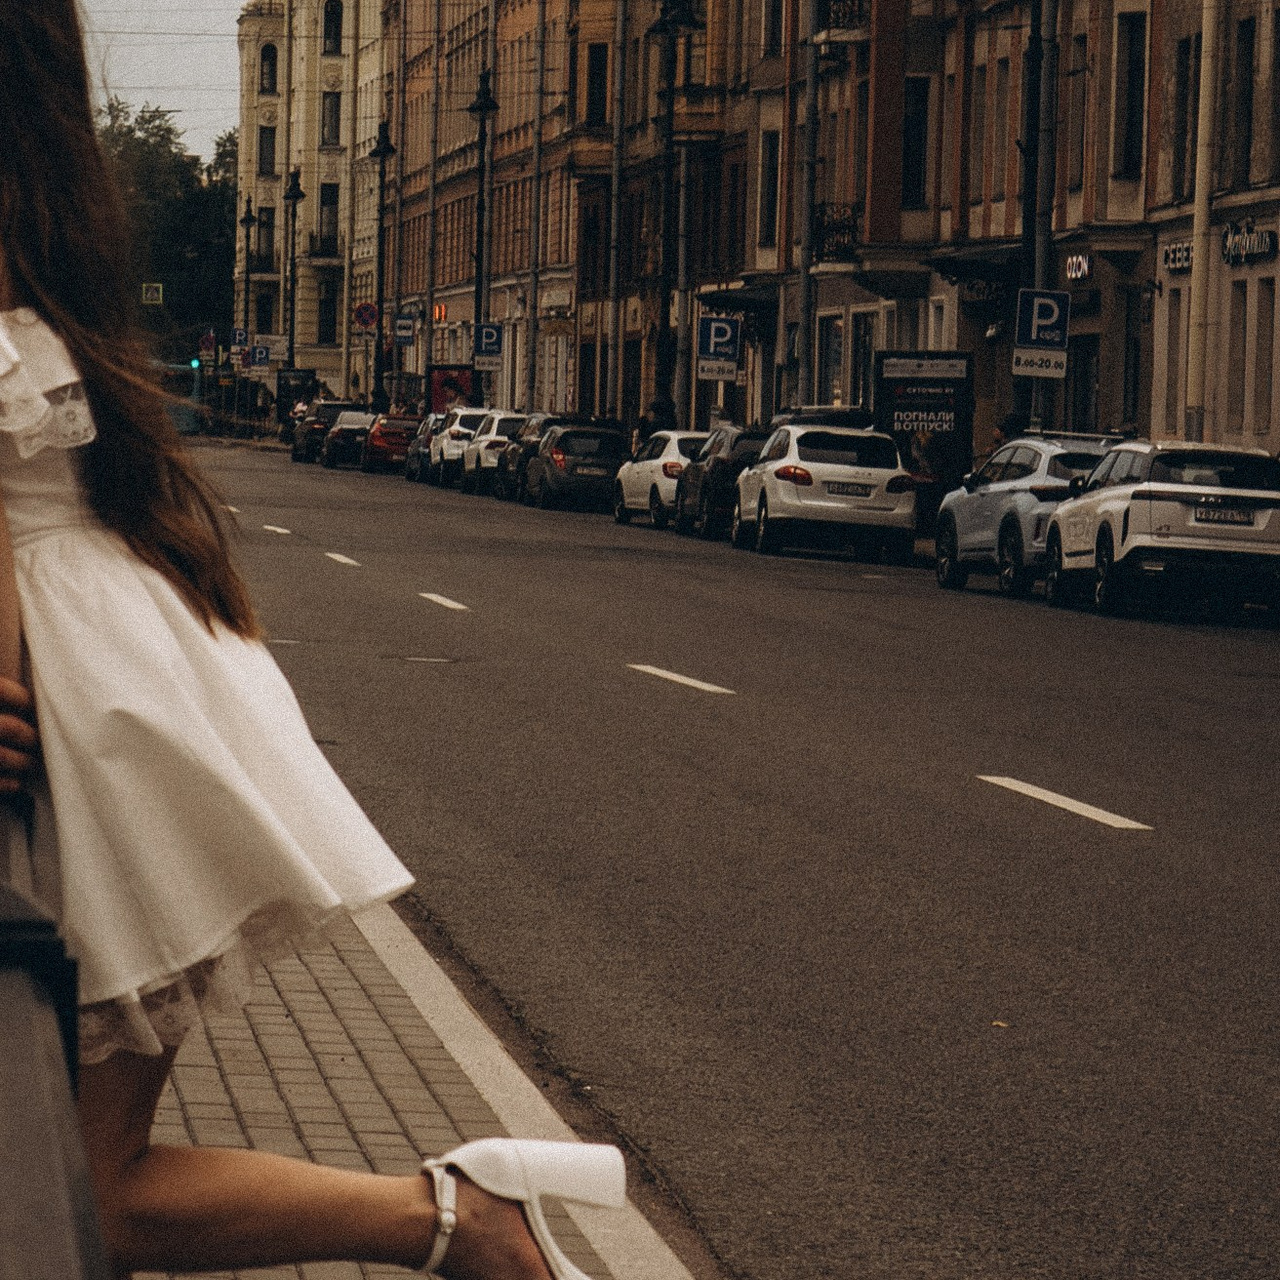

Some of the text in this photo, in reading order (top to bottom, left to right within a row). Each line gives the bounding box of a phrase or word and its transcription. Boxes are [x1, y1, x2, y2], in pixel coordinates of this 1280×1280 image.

[1066, 255, 1090, 280] OZON
[1031, 296, 1060, 341] P
[236, 330, 247, 344] P
[481, 328, 498, 352] P
[709, 321, 733, 354] P
[256, 348, 267, 363] P
[894, 411, 955, 421] ПОГНАЛИ
